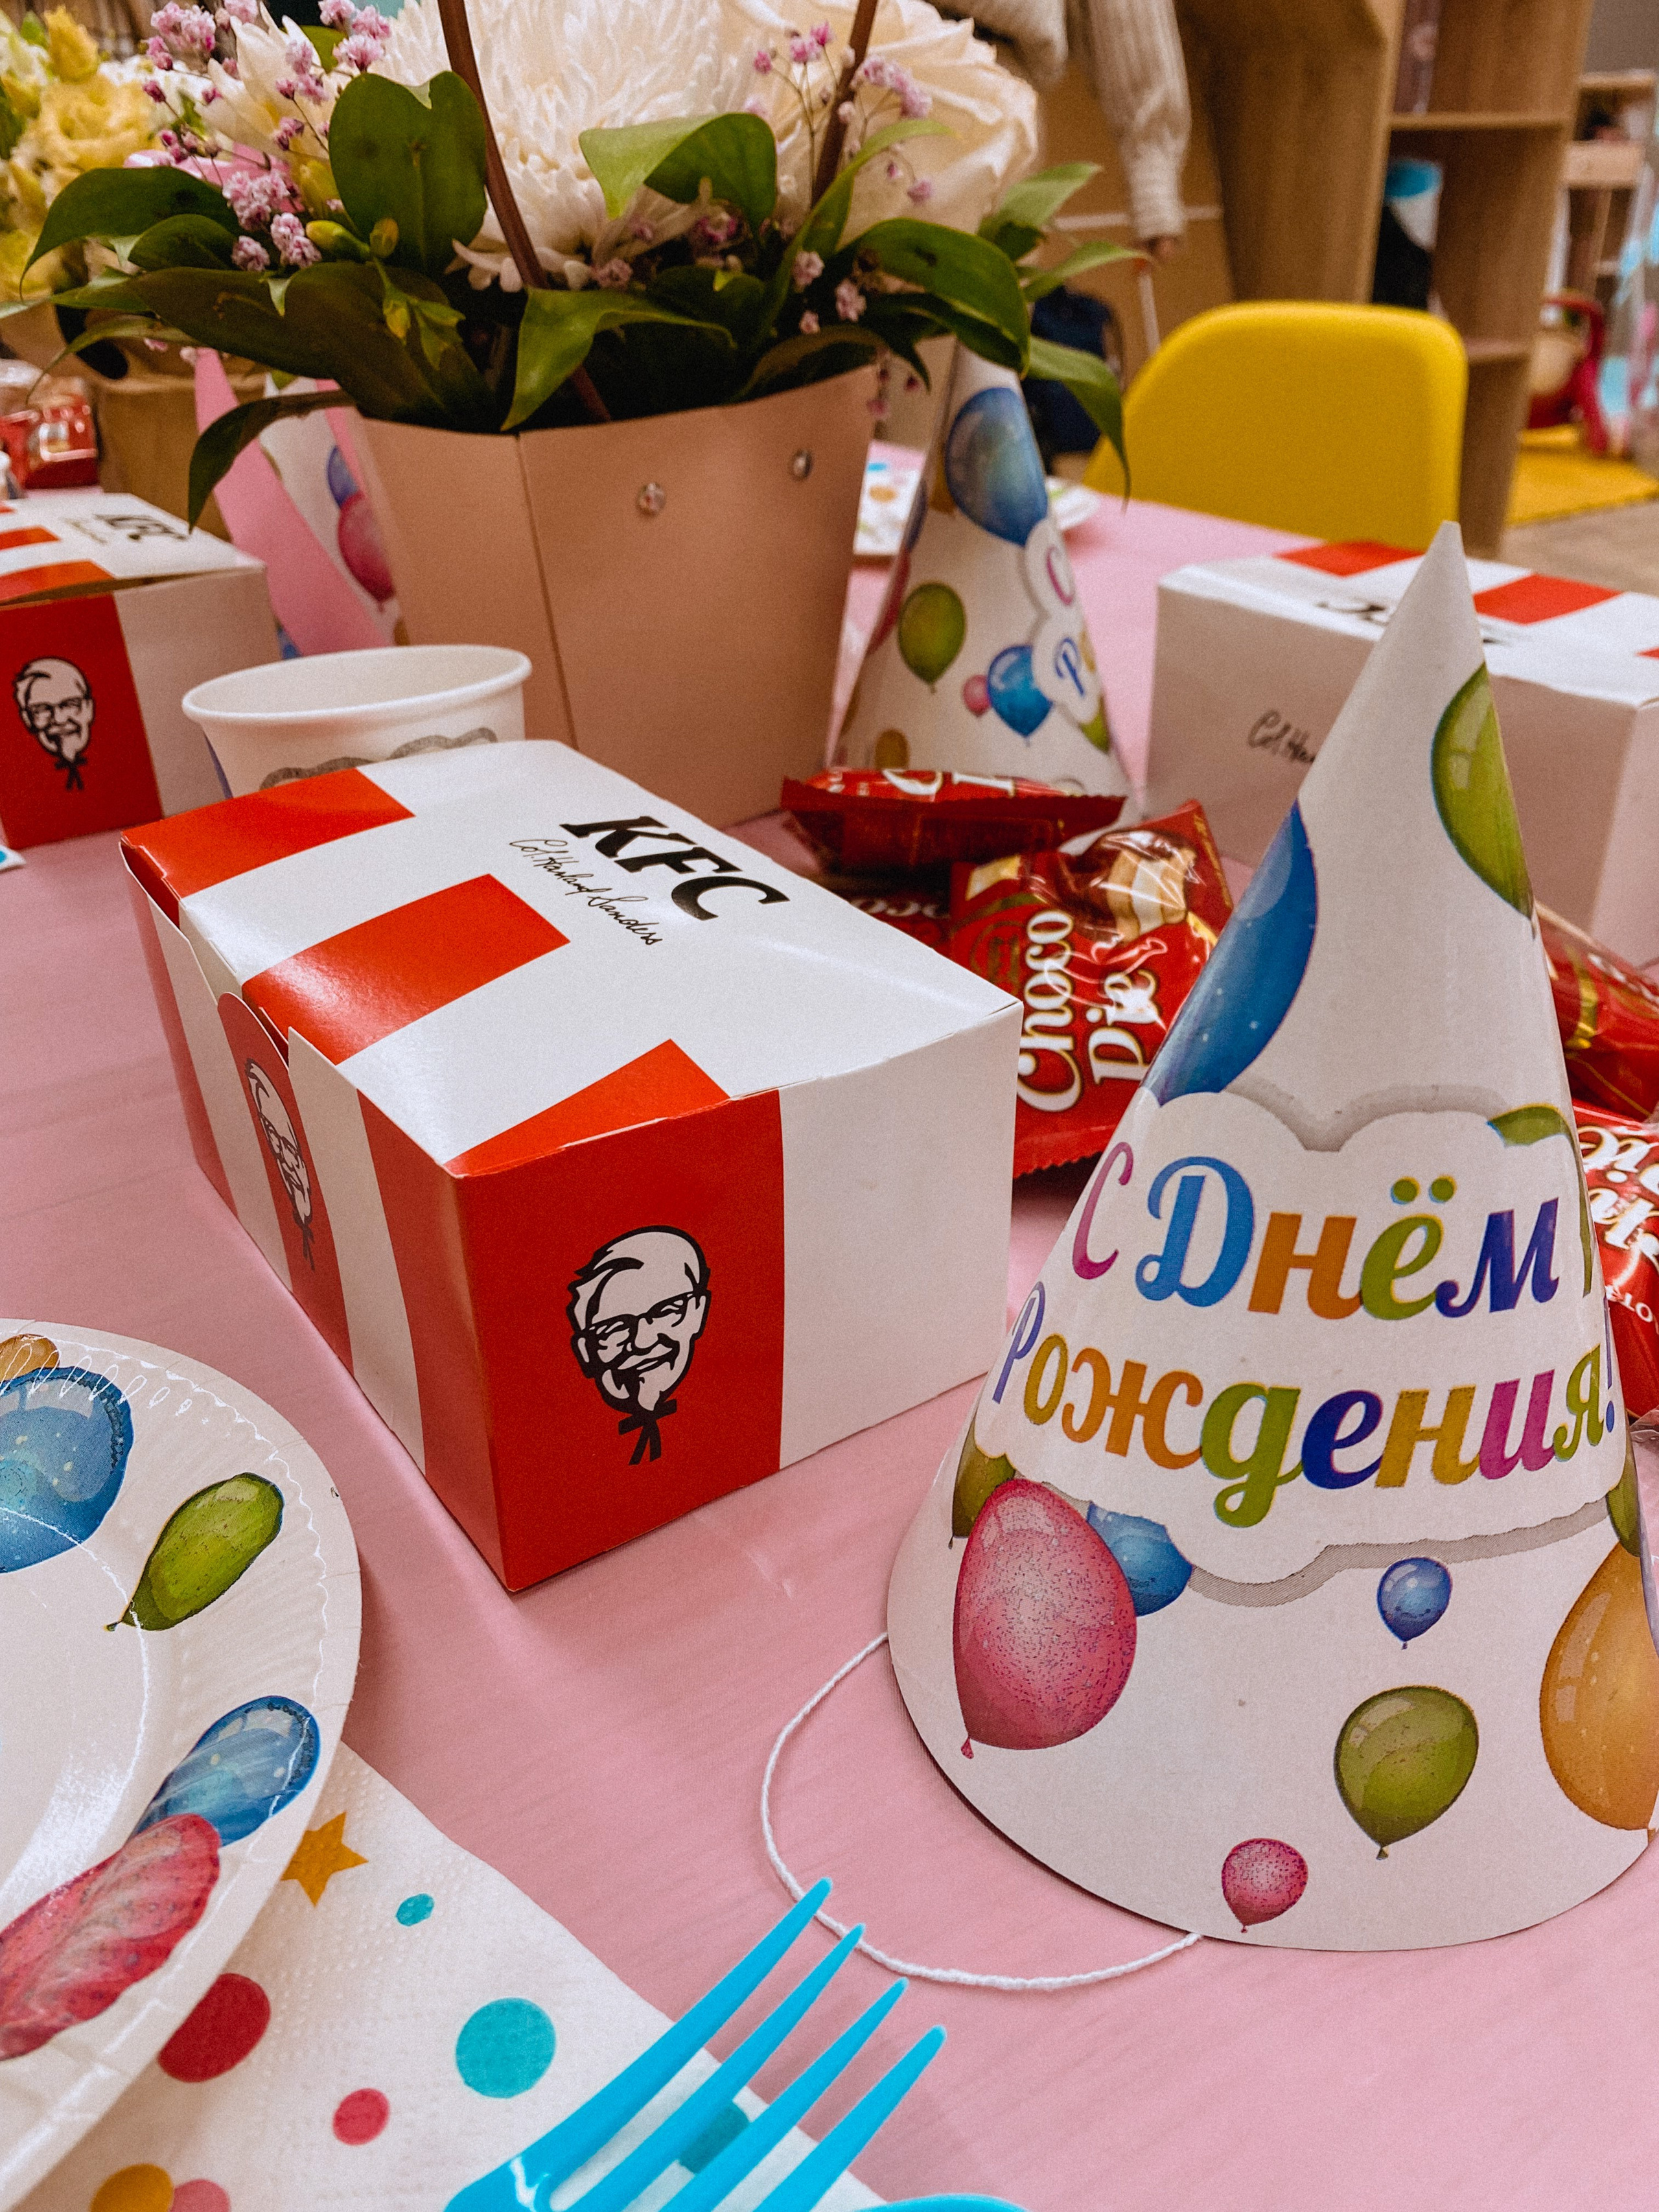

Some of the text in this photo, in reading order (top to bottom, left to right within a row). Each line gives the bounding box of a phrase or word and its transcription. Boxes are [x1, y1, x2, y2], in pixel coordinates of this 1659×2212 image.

[559, 815, 791, 922] KFC
[586, 895, 663, 946] Sanders
[1016, 909, 1084, 1113] Choco
[1085, 968, 1159, 1086] Pie
[1072, 1141, 1134, 1280] С
[1135, 1156, 1560, 1321] Днём
[991, 1281, 1616, 1529] Рождения!
